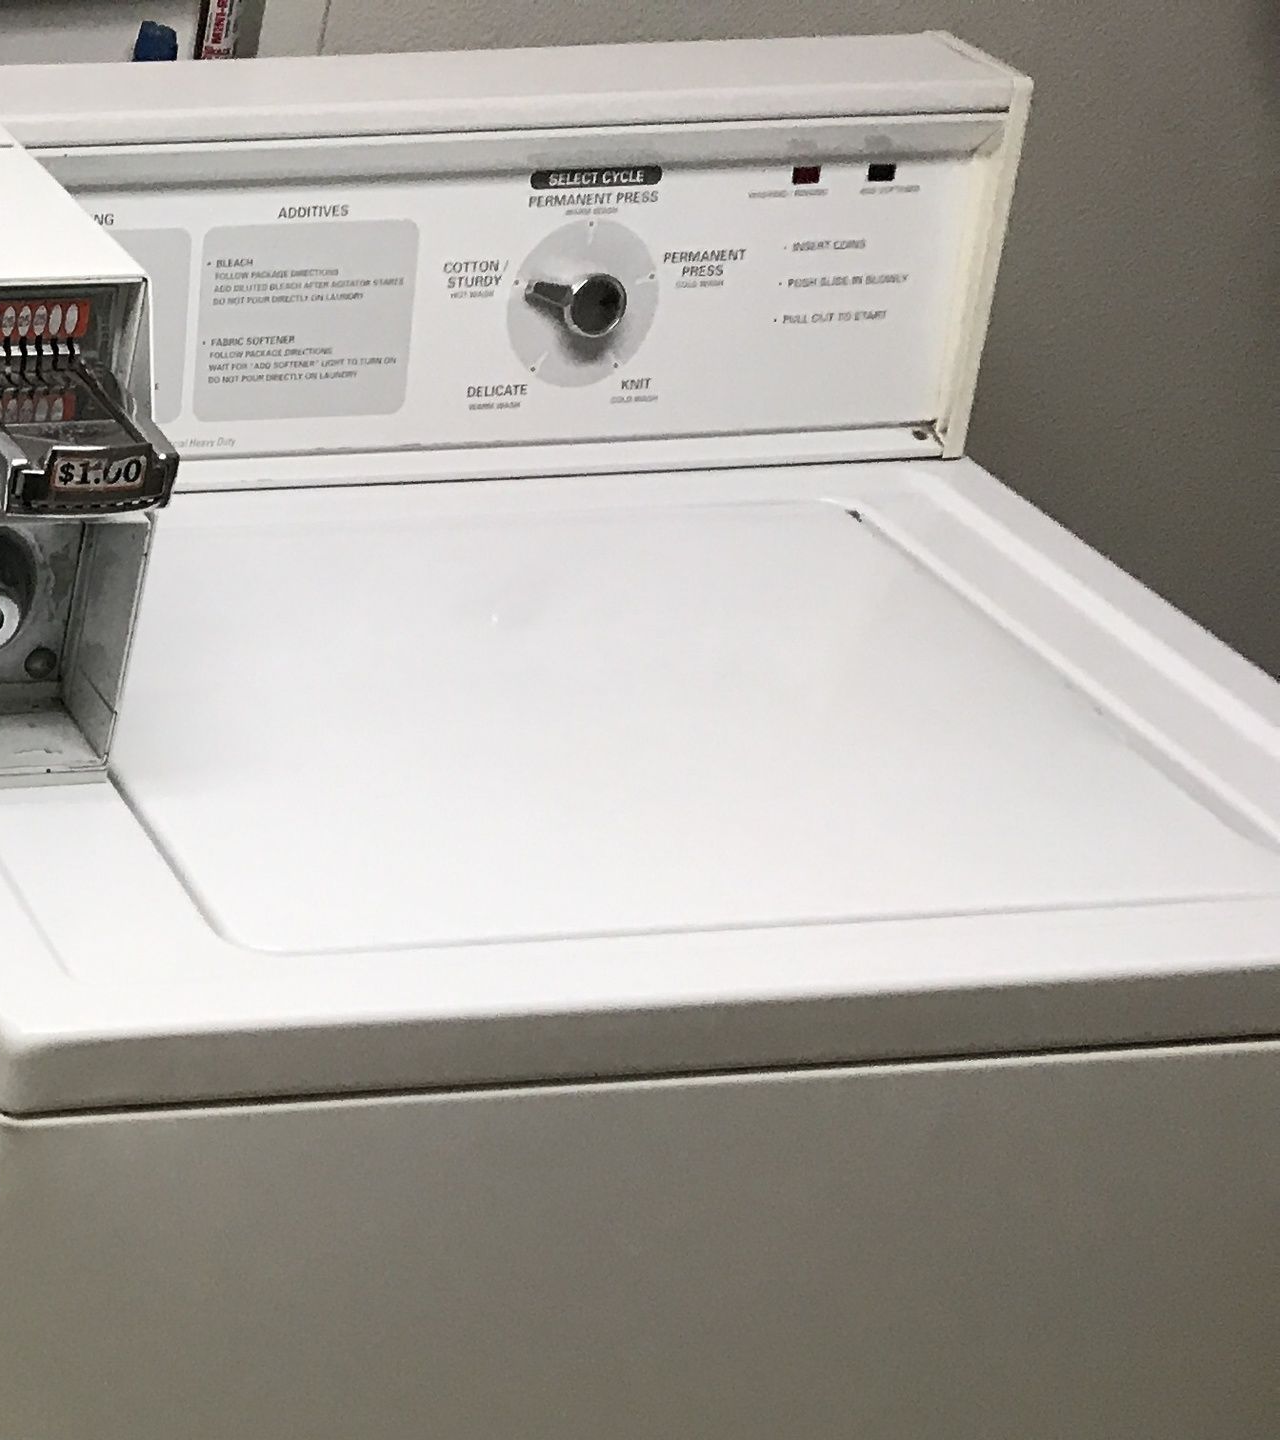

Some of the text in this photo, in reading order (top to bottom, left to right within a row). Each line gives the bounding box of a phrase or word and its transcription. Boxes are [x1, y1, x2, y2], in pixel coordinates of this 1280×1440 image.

[549, 170, 644, 187] SELECT CYCLE
[529, 191, 659, 208] PERMANENT PRESS
[278, 205, 349, 219] ADDITIVES
[217, 259, 253, 268] BLEACH
[664, 249, 747, 264] PERMANENT
[443, 260, 500, 274] COTTON
[682, 265, 724, 278] PRESS
[448, 275, 503, 289] STURDY
[211, 336, 295, 347] FABRIC SOFTENER
[467, 384, 528, 398] DELICATE
[621, 378, 652, 390] KNIT
[190, 438, 215, 448] Heavy
[217, 437, 236, 447] Duty
[59, 458, 142, 485] $1.00
